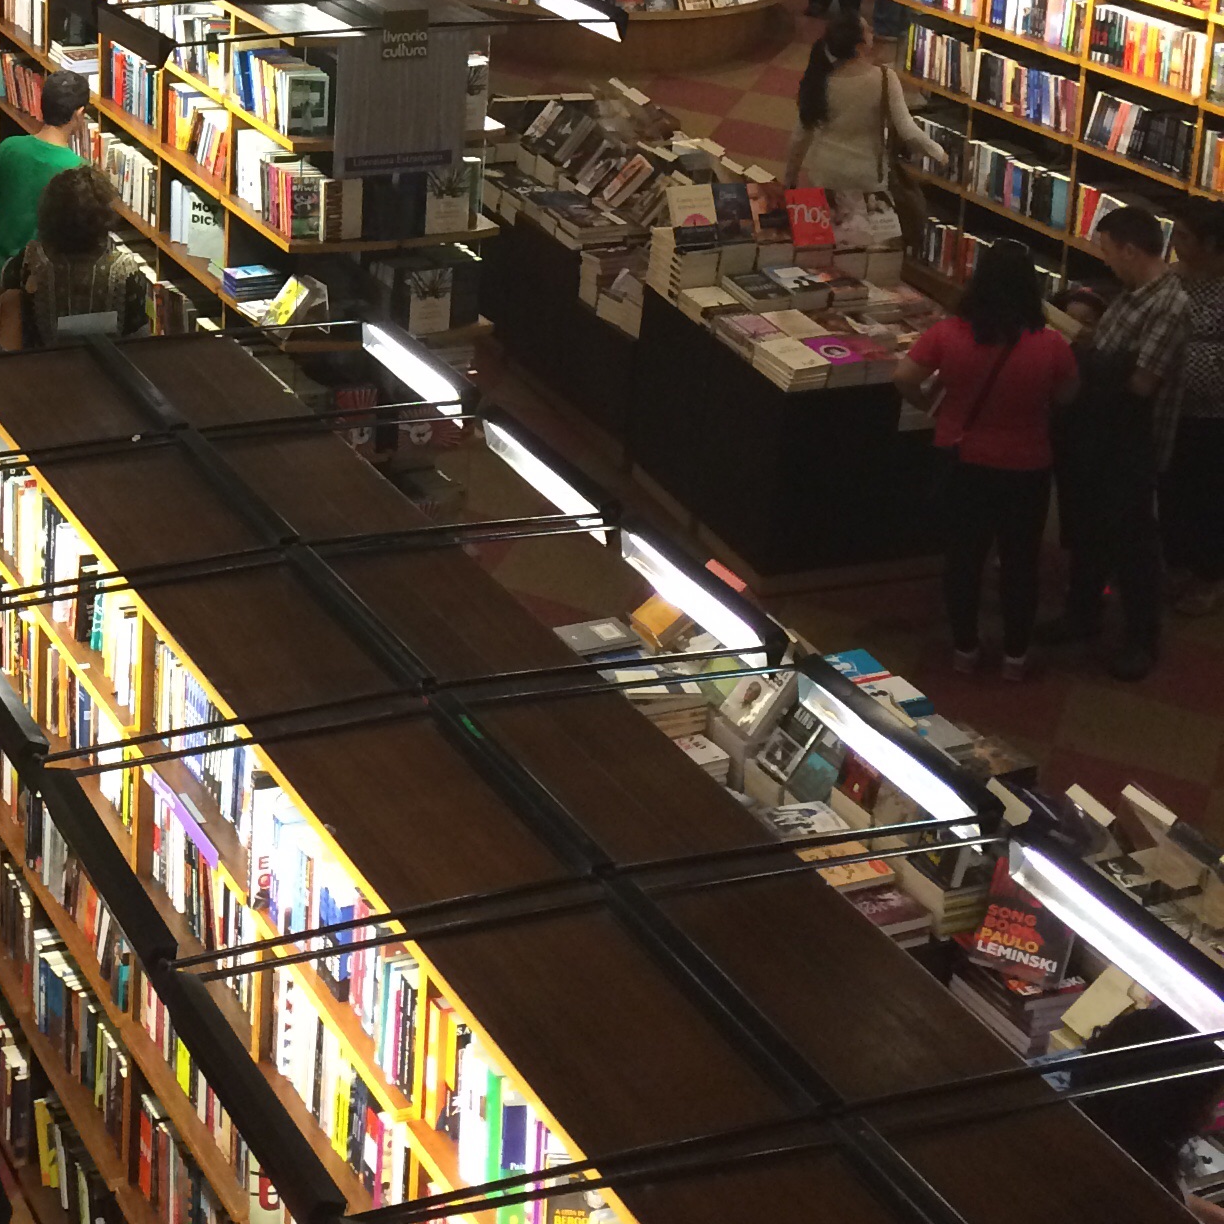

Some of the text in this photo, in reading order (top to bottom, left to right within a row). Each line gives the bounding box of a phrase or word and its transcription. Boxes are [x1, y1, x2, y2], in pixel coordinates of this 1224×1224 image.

[382, 29, 428, 45] livraria
[382, 43, 428, 59] cultura
[793, 706, 817, 730] KING
[987, 903, 1037, 928] SONG
[980, 926, 1040, 954] PAULO
[976, 939, 1058, 973] LEMINSKI
